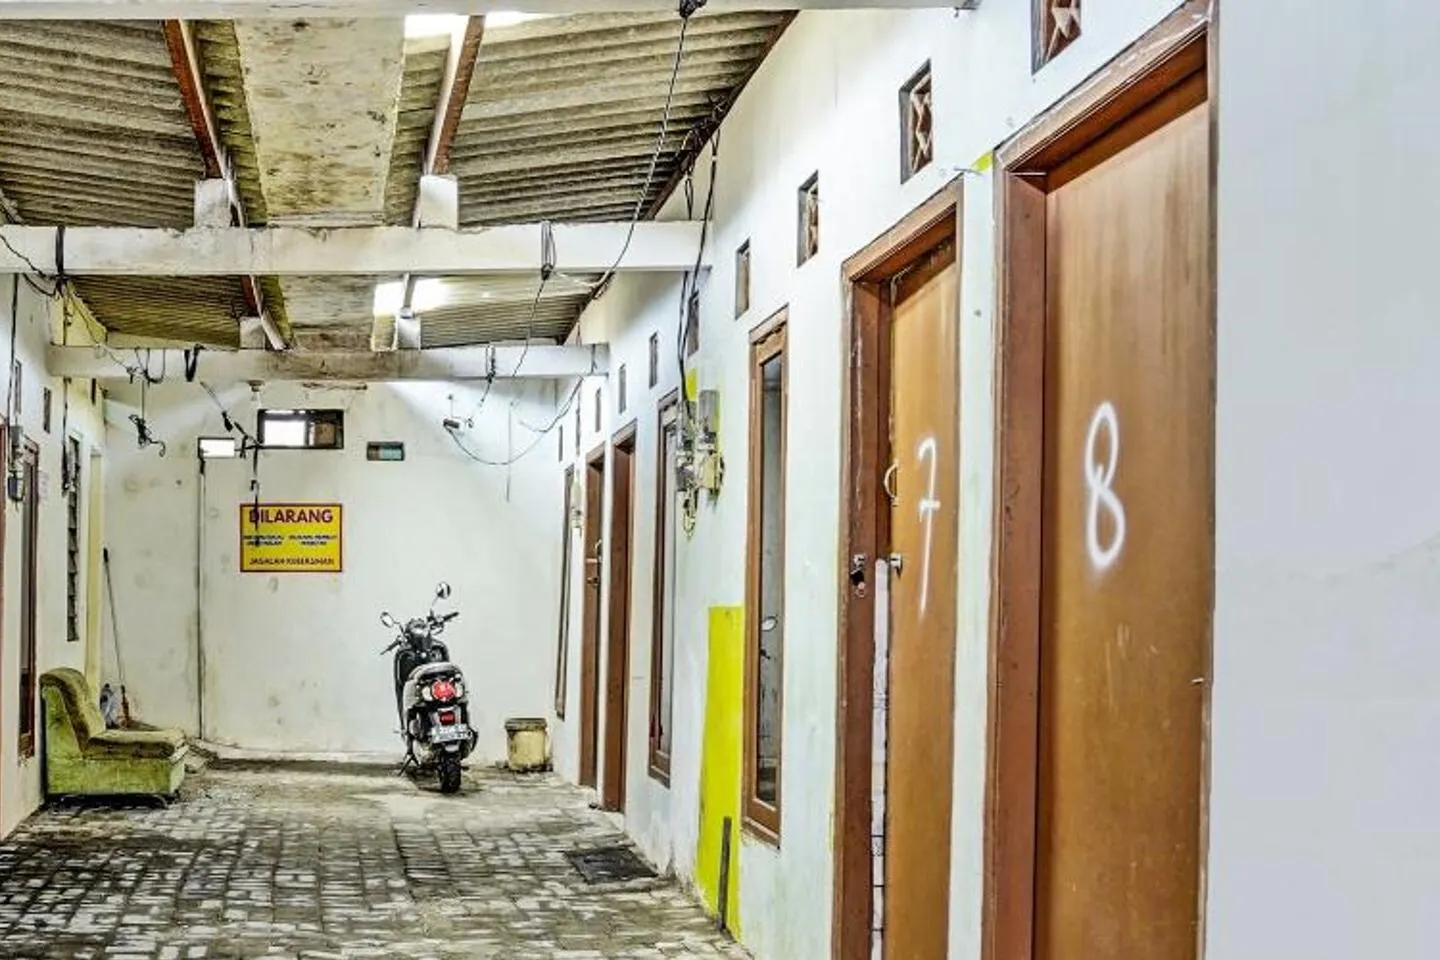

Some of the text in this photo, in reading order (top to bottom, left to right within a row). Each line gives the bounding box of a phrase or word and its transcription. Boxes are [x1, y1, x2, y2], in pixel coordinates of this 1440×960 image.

[249, 509, 333, 523] DILARANG
[917, 436, 941, 613] 7
[1085, 401, 1125, 569] 8
